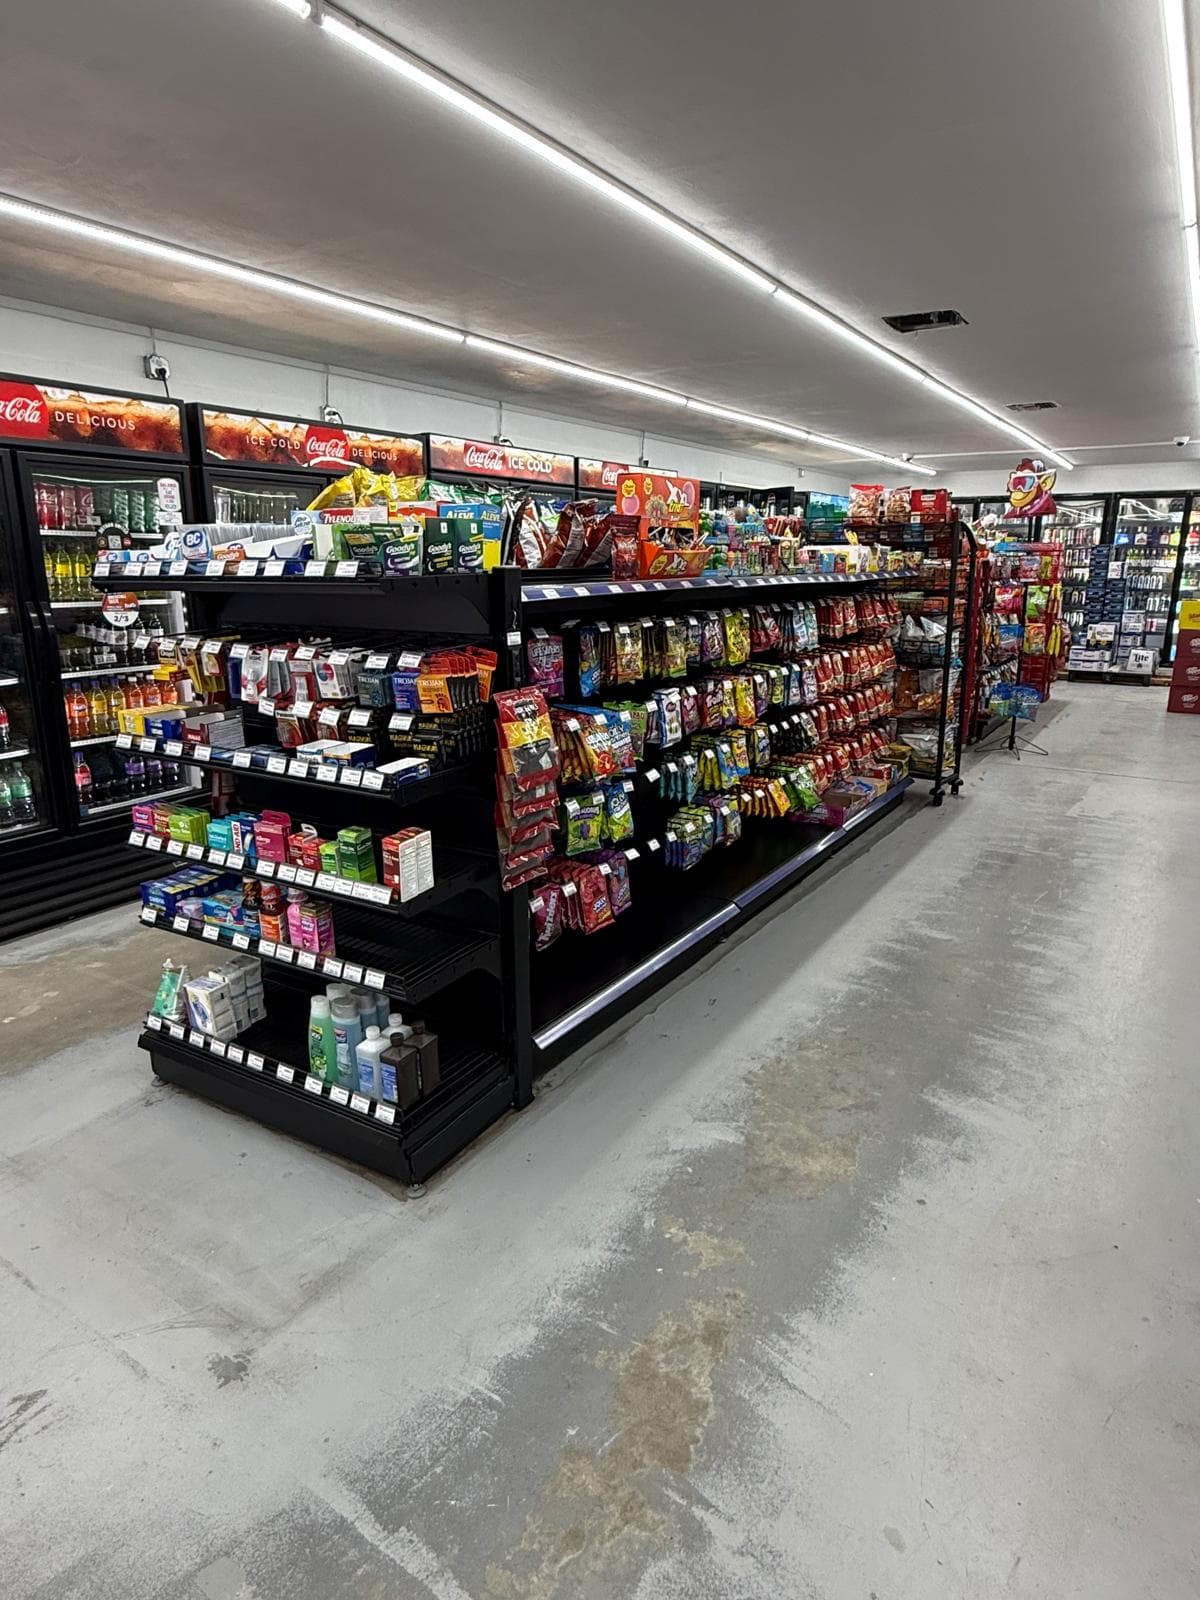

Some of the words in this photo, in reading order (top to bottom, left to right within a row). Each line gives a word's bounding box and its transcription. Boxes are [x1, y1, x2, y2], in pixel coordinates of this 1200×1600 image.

[54, 410, 137, 431] DELICIOUS
[246, 435, 265, 446] ICE
[271, 438, 300, 450] COLD
[305, 436, 347, 458] Coca-Cola
[352, 448, 399, 462] DELICIOUS
[464, 445, 505, 471] Coca-Cola
[508, 457, 525, 470] ICE
[527, 460, 552, 474] COLD
[185, 533, 201, 546] BC
[386, 543, 415, 555] Goody's
[1134, 653, 1150, 663] Lite
[419, 679, 445, 687] TROJAN
